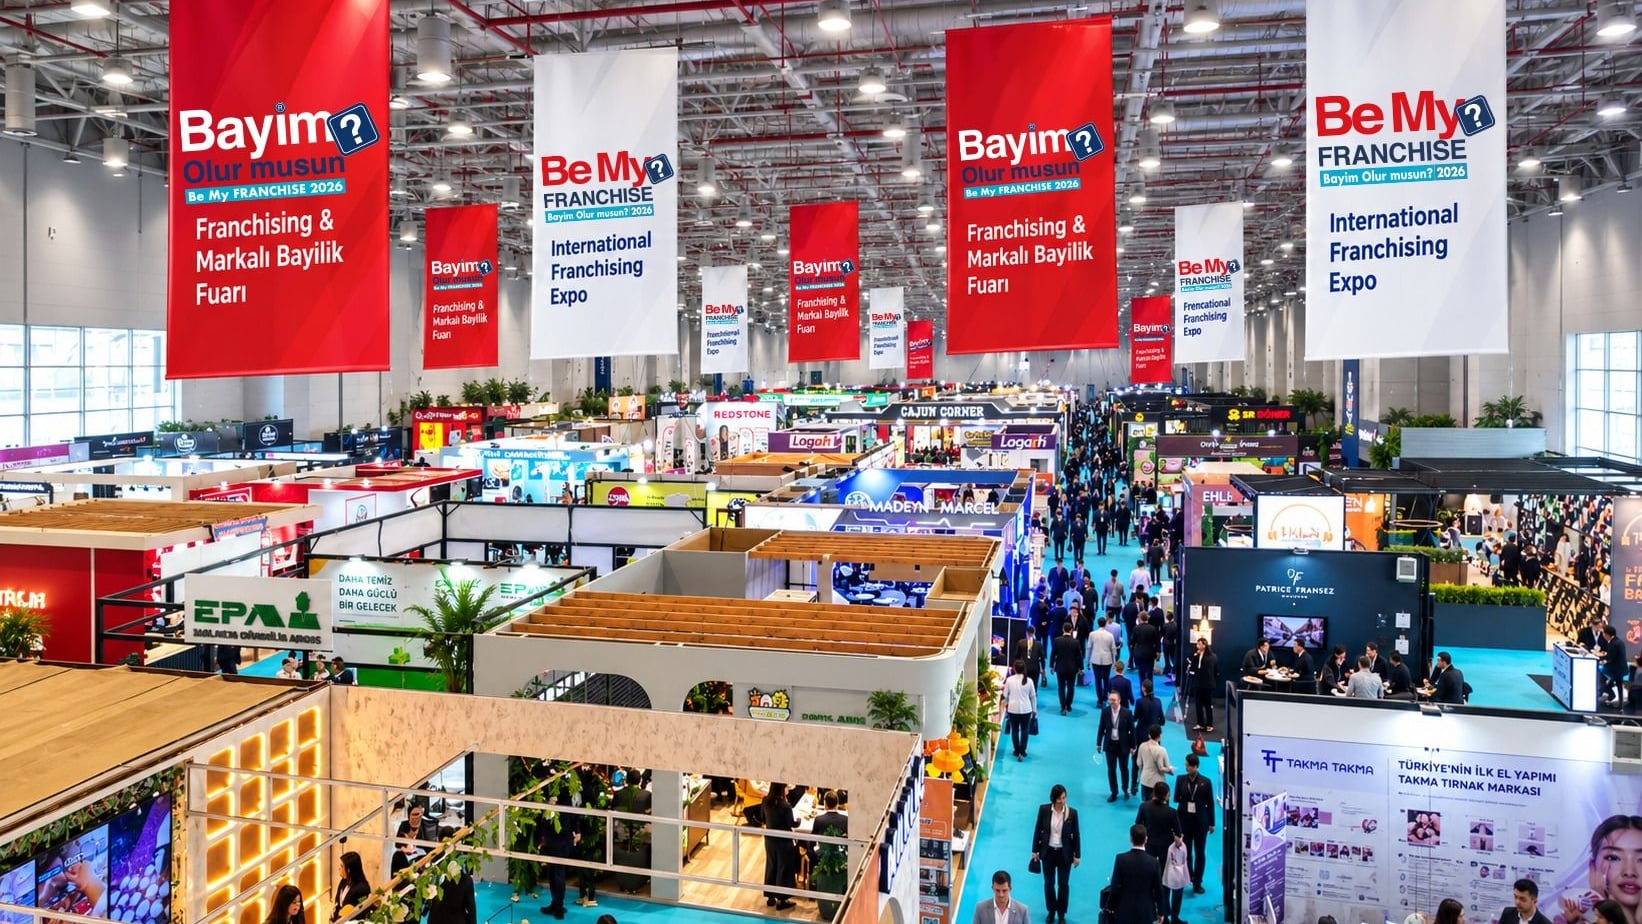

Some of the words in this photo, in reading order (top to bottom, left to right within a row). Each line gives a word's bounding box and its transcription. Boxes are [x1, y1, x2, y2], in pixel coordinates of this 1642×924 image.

[1316, 95, 1384, 136] Be
[1392, 91, 1465, 140] My
[179, 102, 335, 160] Bayim
[958, 123, 1072, 165] Bayim
[1318, 139, 1466, 167] FRANCHISE
[183, 160, 243, 184] Olur
[250, 156, 345, 180] musun
[541, 155, 592, 186] Be
[596, 151, 651, 187] My
[962, 166, 1005, 184] Olur
[1011, 161, 1080, 180] musun
[1323, 173, 1358, 186] Bayim
[1362, 170, 1386, 182] Olur
[1390, 168, 1433, 181] musun?
[1437, 166, 1466, 179] 2026
[188, 192, 204, 202] Be
[209, 189, 229, 202] My
[233, 184, 306, 199] FRANCHISE
[310, 181, 343, 194] 2026
[543, 187, 654, 208] FRANCHISE
[966, 189, 978, 197] Be
[981, 188, 996, 198] My
[999, 183, 1052, 194] FRANCHISE
[1055, 181, 1079, 190] 2026
[196, 211, 313, 240] Franchising
[319, 208, 334, 231] &
[547, 212, 574, 223] Bayim
[576, 210, 597, 219] Olur
[598, 207, 629, 218] musun?
[631, 206, 653, 216] 2026
[1330, 202, 1458, 233] International
[968, 217, 1066, 242] Franchising
[1072, 215, 1086, 234] &
[551, 231, 652, 257] International
[968, 246, 1029, 268] Markalı
[1034, 241, 1093, 267] Bayilik
[1330, 235, 1448, 262] Franchising
[196, 245, 270, 273] Markalı
[276, 240, 344, 270] Bayilik
[1178, 260, 1203, 276] Be
[1204, 258, 1230, 276] My
[431, 259, 479, 277] Bayim
[551, 258, 644, 280] Franchising
[793, 260, 841, 277] Bayim
[968, 276, 1009, 295] Fuarı
[1180, 274, 1232, 286] FRANCHISE
[1329, 272, 1377, 295] Expo
[196, 282, 247, 306] Fuarı
[550, 287, 588, 308] Expo
[705, 304, 721, 315] Be
[1133, 323, 1162, 334] Bayim
[1183, 327, 1202, 338] Expo
[713, 410, 771, 419] REDSTONE
[940, 406, 984, 417] CORNER
[939, 501, 1000, 515] MARCEL
[338, 574, 364, 584] DAHA
[1255, 584, 1292, 594] PATRICE
[1295, 586, 1336, 595] FRANSEZ
[339, 587, 364, 597] DAHA
[339, 600, 354, 610] BİR
[356, 601, 398, 613] GELECEK
[1286, 758, 1328, 771] TAKMA
[1332, 762, 1374, 775] TAKMA
[1398, 759, 1472, 776] TÜRKİYE'NİN
[1475, 764, 1494, 778] İLK
[1497, 768, 1512, 779] EL
[1514, 770, 1557, 783] YAPIMI
[1398, 774, 1439, 787] TAKMA
[1441, 778, 1485, 792] TIRNAK
[1487, 782, 1541, 797] MARKASI
